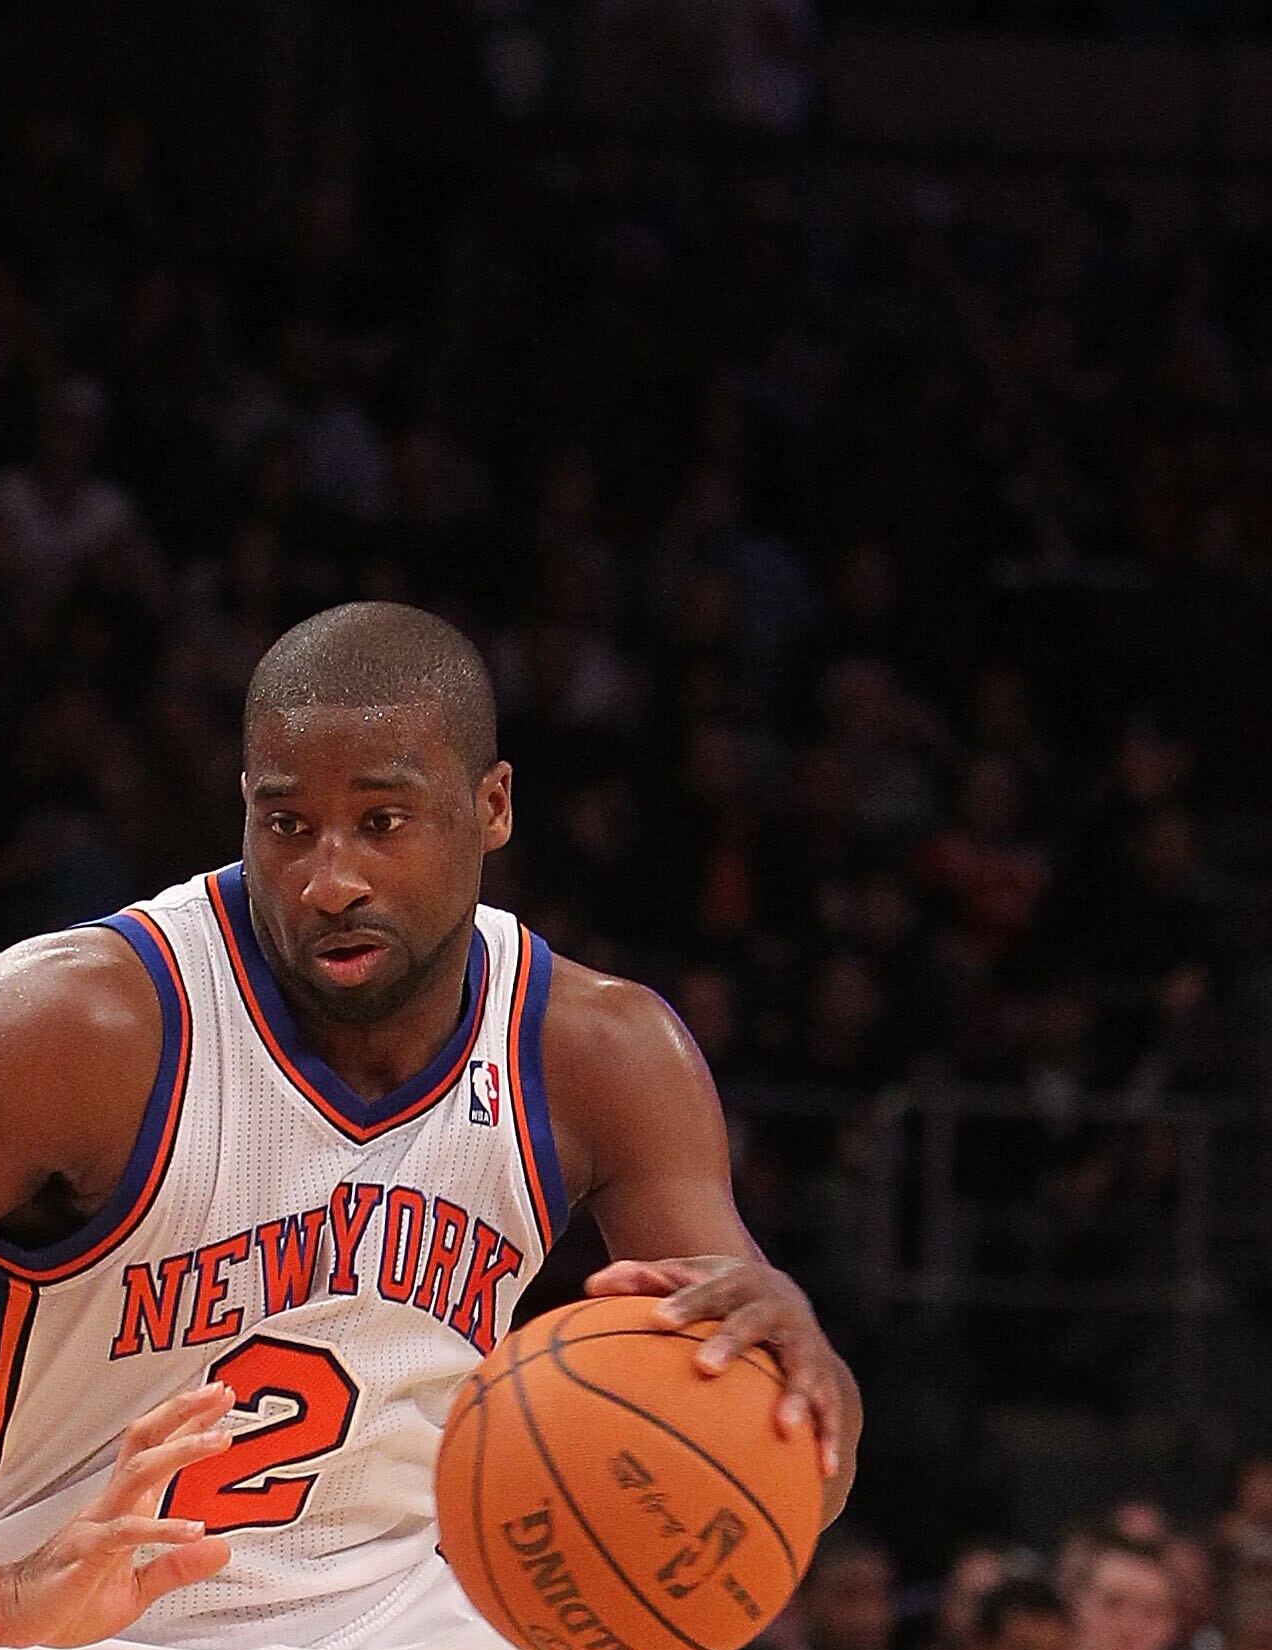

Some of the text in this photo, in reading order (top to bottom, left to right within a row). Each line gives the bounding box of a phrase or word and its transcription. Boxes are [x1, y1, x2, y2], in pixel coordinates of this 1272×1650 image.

[109, 1182, 524, 1361] NEW YORK
[158, 1333, 360, 1536] 2
